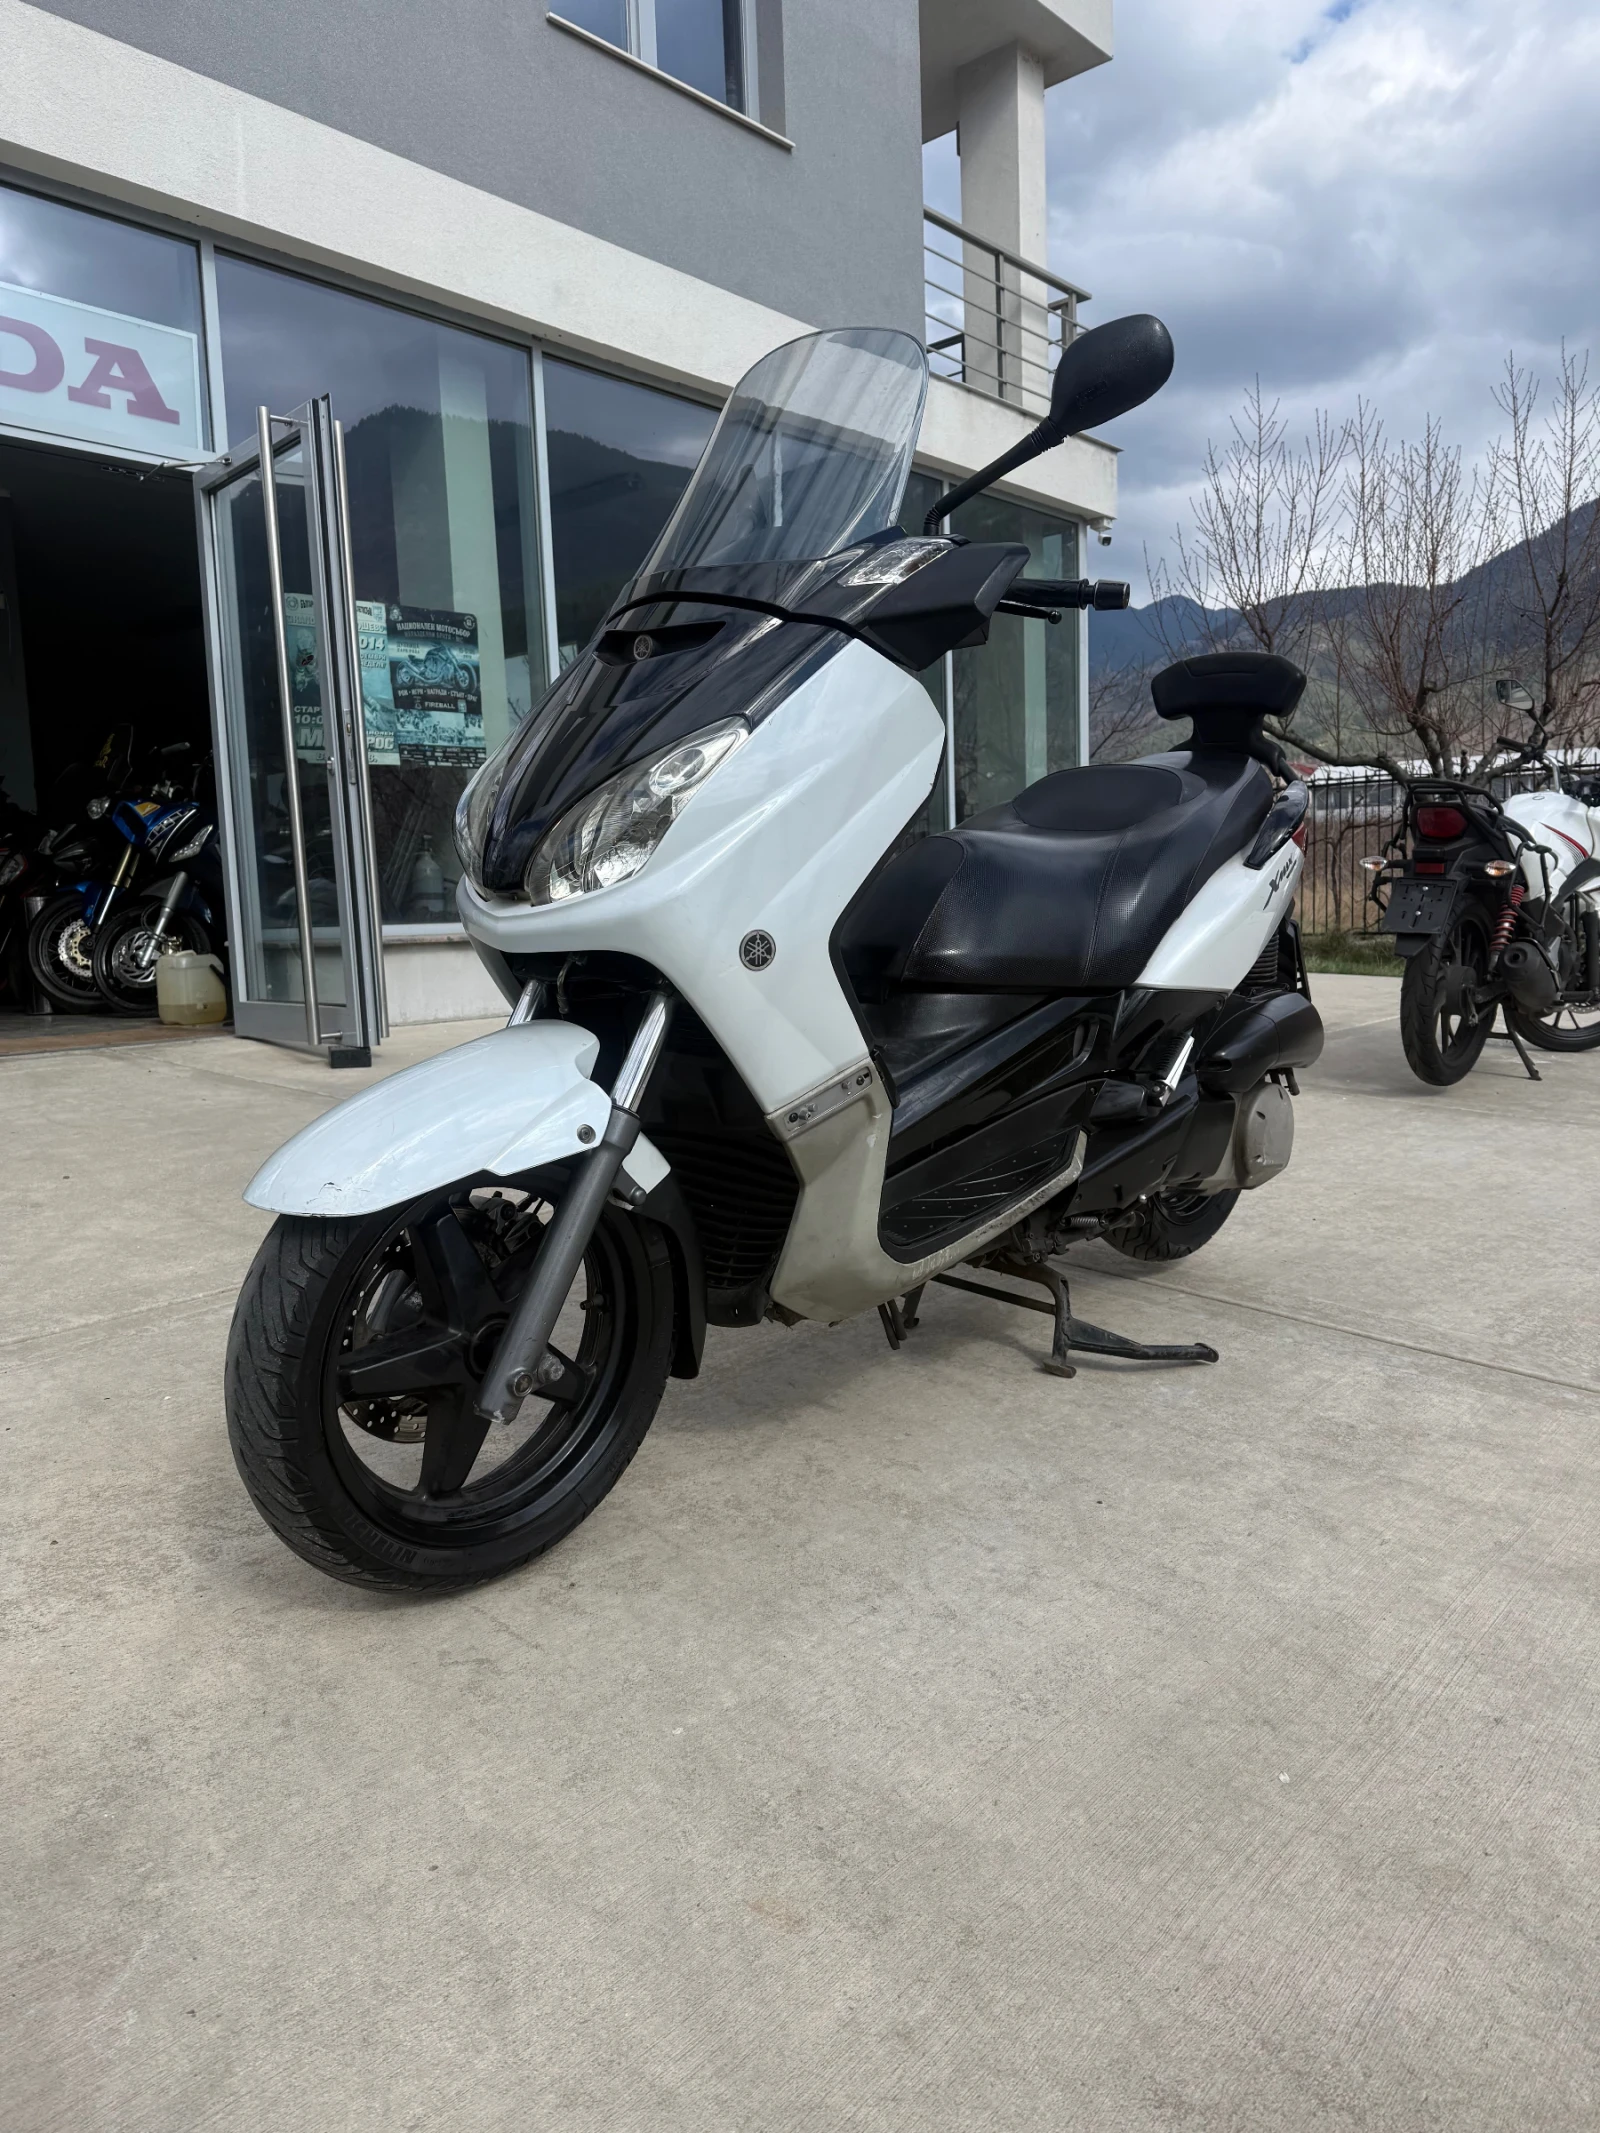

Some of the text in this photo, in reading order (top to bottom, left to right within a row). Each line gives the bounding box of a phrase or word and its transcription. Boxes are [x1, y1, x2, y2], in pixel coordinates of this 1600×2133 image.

[359, 636, 386, 651] 014
[294, 705, 322, 713] СТАР
[424, 701, 455, 709] FIREBALL
